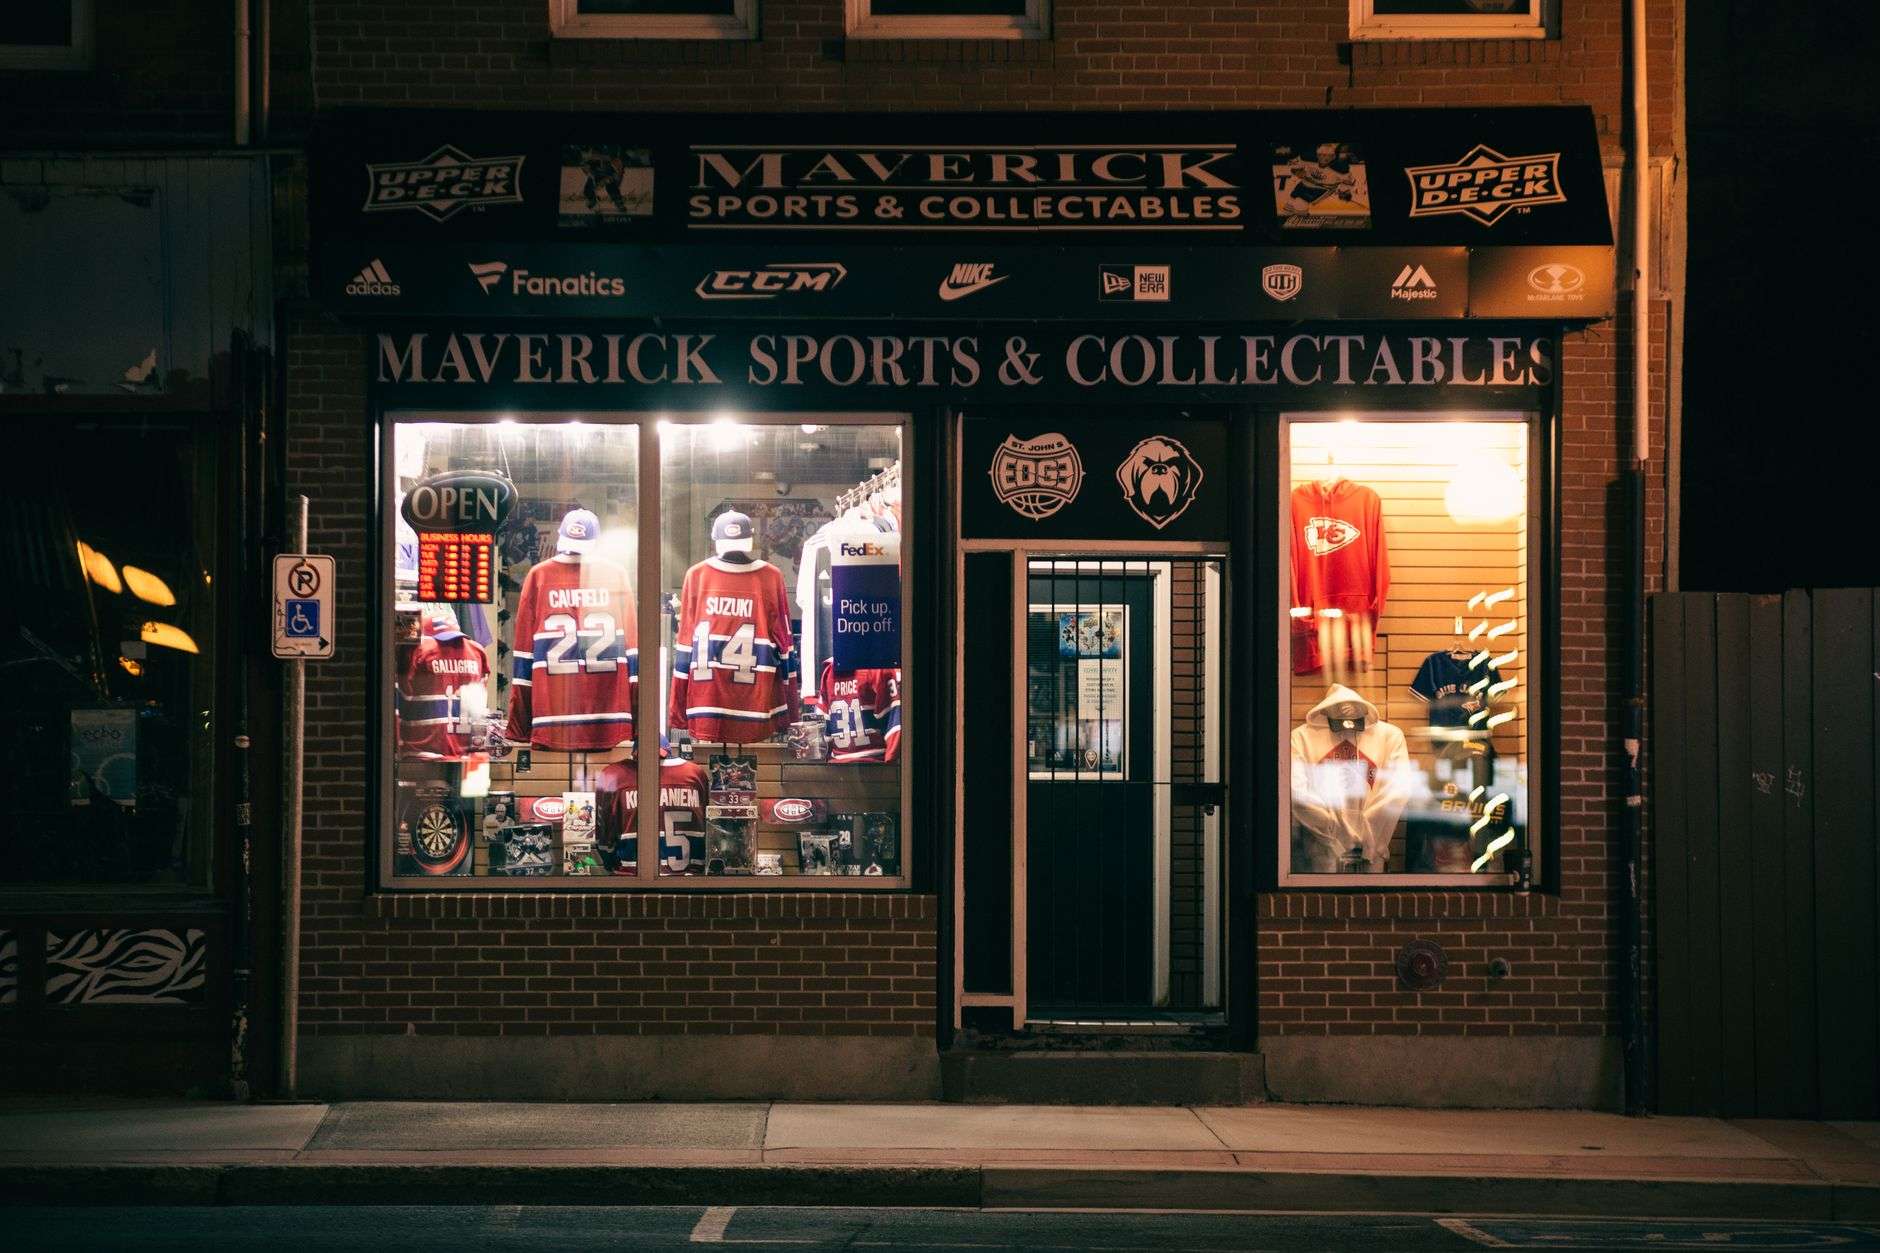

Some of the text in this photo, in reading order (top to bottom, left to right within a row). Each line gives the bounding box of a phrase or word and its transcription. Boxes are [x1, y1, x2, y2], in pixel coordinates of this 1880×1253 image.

[379, 164, 512, 187] UPPER
[689, 152, 1240, 189] MAVERICK
[1419, 163, 1550, 190] UPPER
[689, 194, 1242, 219] SPORTS & COLLECTABLES
[512, 269, 626, 297] Fanatics
[711, 271, 832, 292] CCM
[949, 263, 995, 284] NIKE
[1139, 273, 1165, 284] NEW
[345, 281, 401, 297] adidas
[1139, 283, 1165, 294] ERA
[1391, 288, 1438, 302] Majestic
[376, 331, 1552, 388] MAVERICK SPORTS & COLLECTABLES
[411, 486, 499, 521] OPEN
[420, 533, 493, 544] BUSINESS HOURS
[841, 542, 884, 556] FedEx
[548, 588, 611, 609] CAUFIELD
[706, 596, 754, 618] SUZUKI
[840, 599, 892, 617] Pick up.
[837, 617, 896, 636] Drop off.
[544, 611, 618, 675] 22
[692, 621, 757, 685] 14
[834, 679, 858, 697] PRICE
[830, 698, 871, 749] 31
